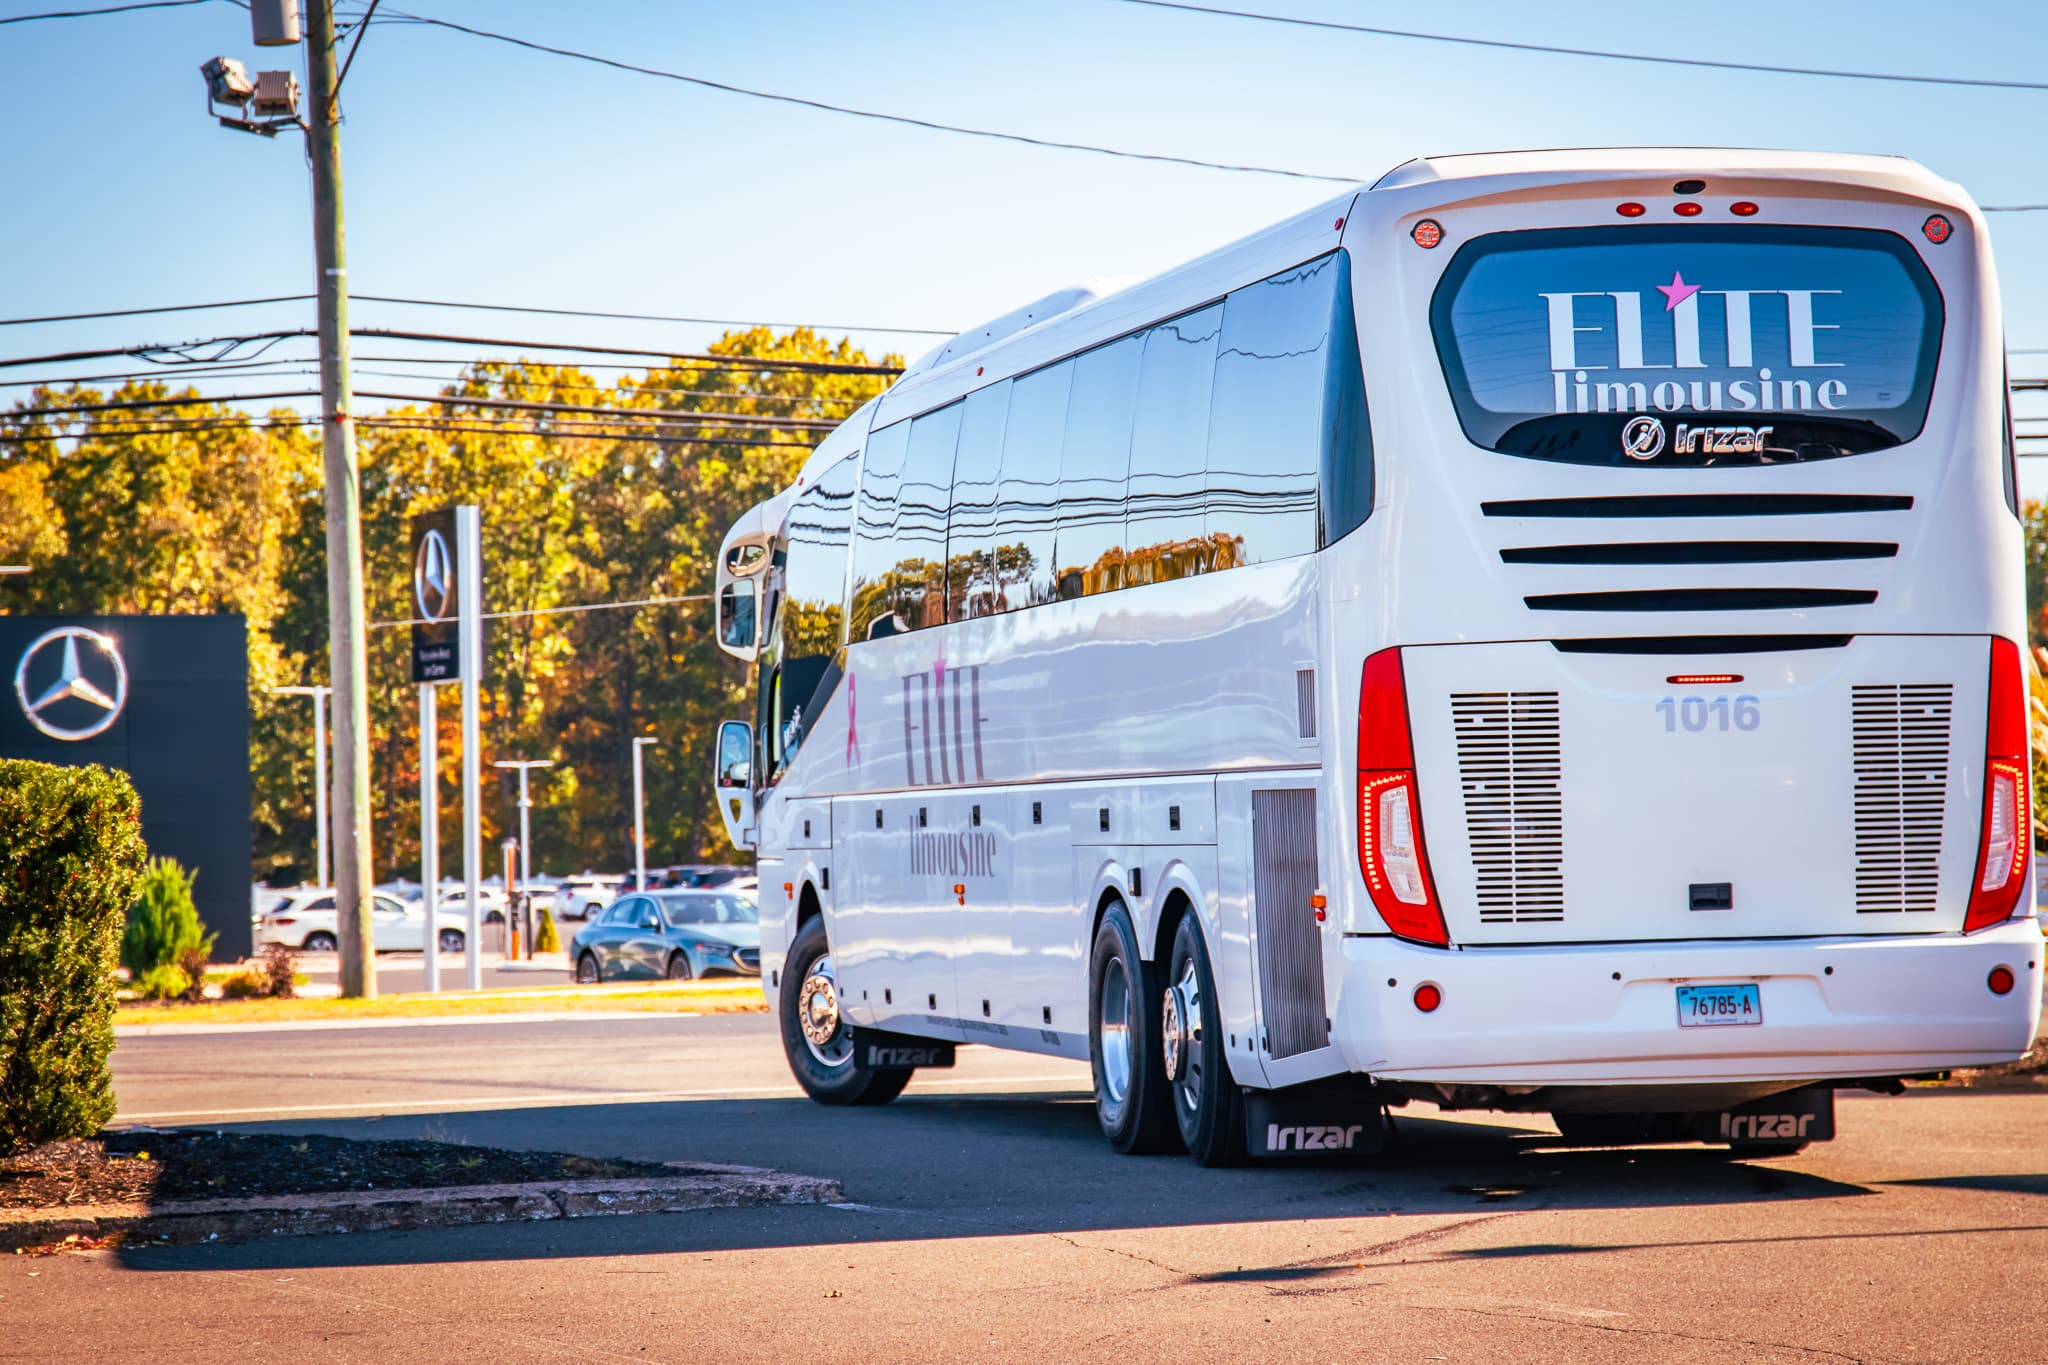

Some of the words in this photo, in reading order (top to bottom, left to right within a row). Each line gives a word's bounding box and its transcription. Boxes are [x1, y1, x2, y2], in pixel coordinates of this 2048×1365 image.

[1552, 368, 1847, 413] limousine
[1675, 423, 1774, 454] Irizar
[1656, 694, 1760, 732] 1016
[909, 813, 996, 878] limousine
[867, 1045, 941, 1067] Irizar
[1267, 1124, 1362, 1151] Irizar
[1720, 1113, 1815, 1139] Irizar
